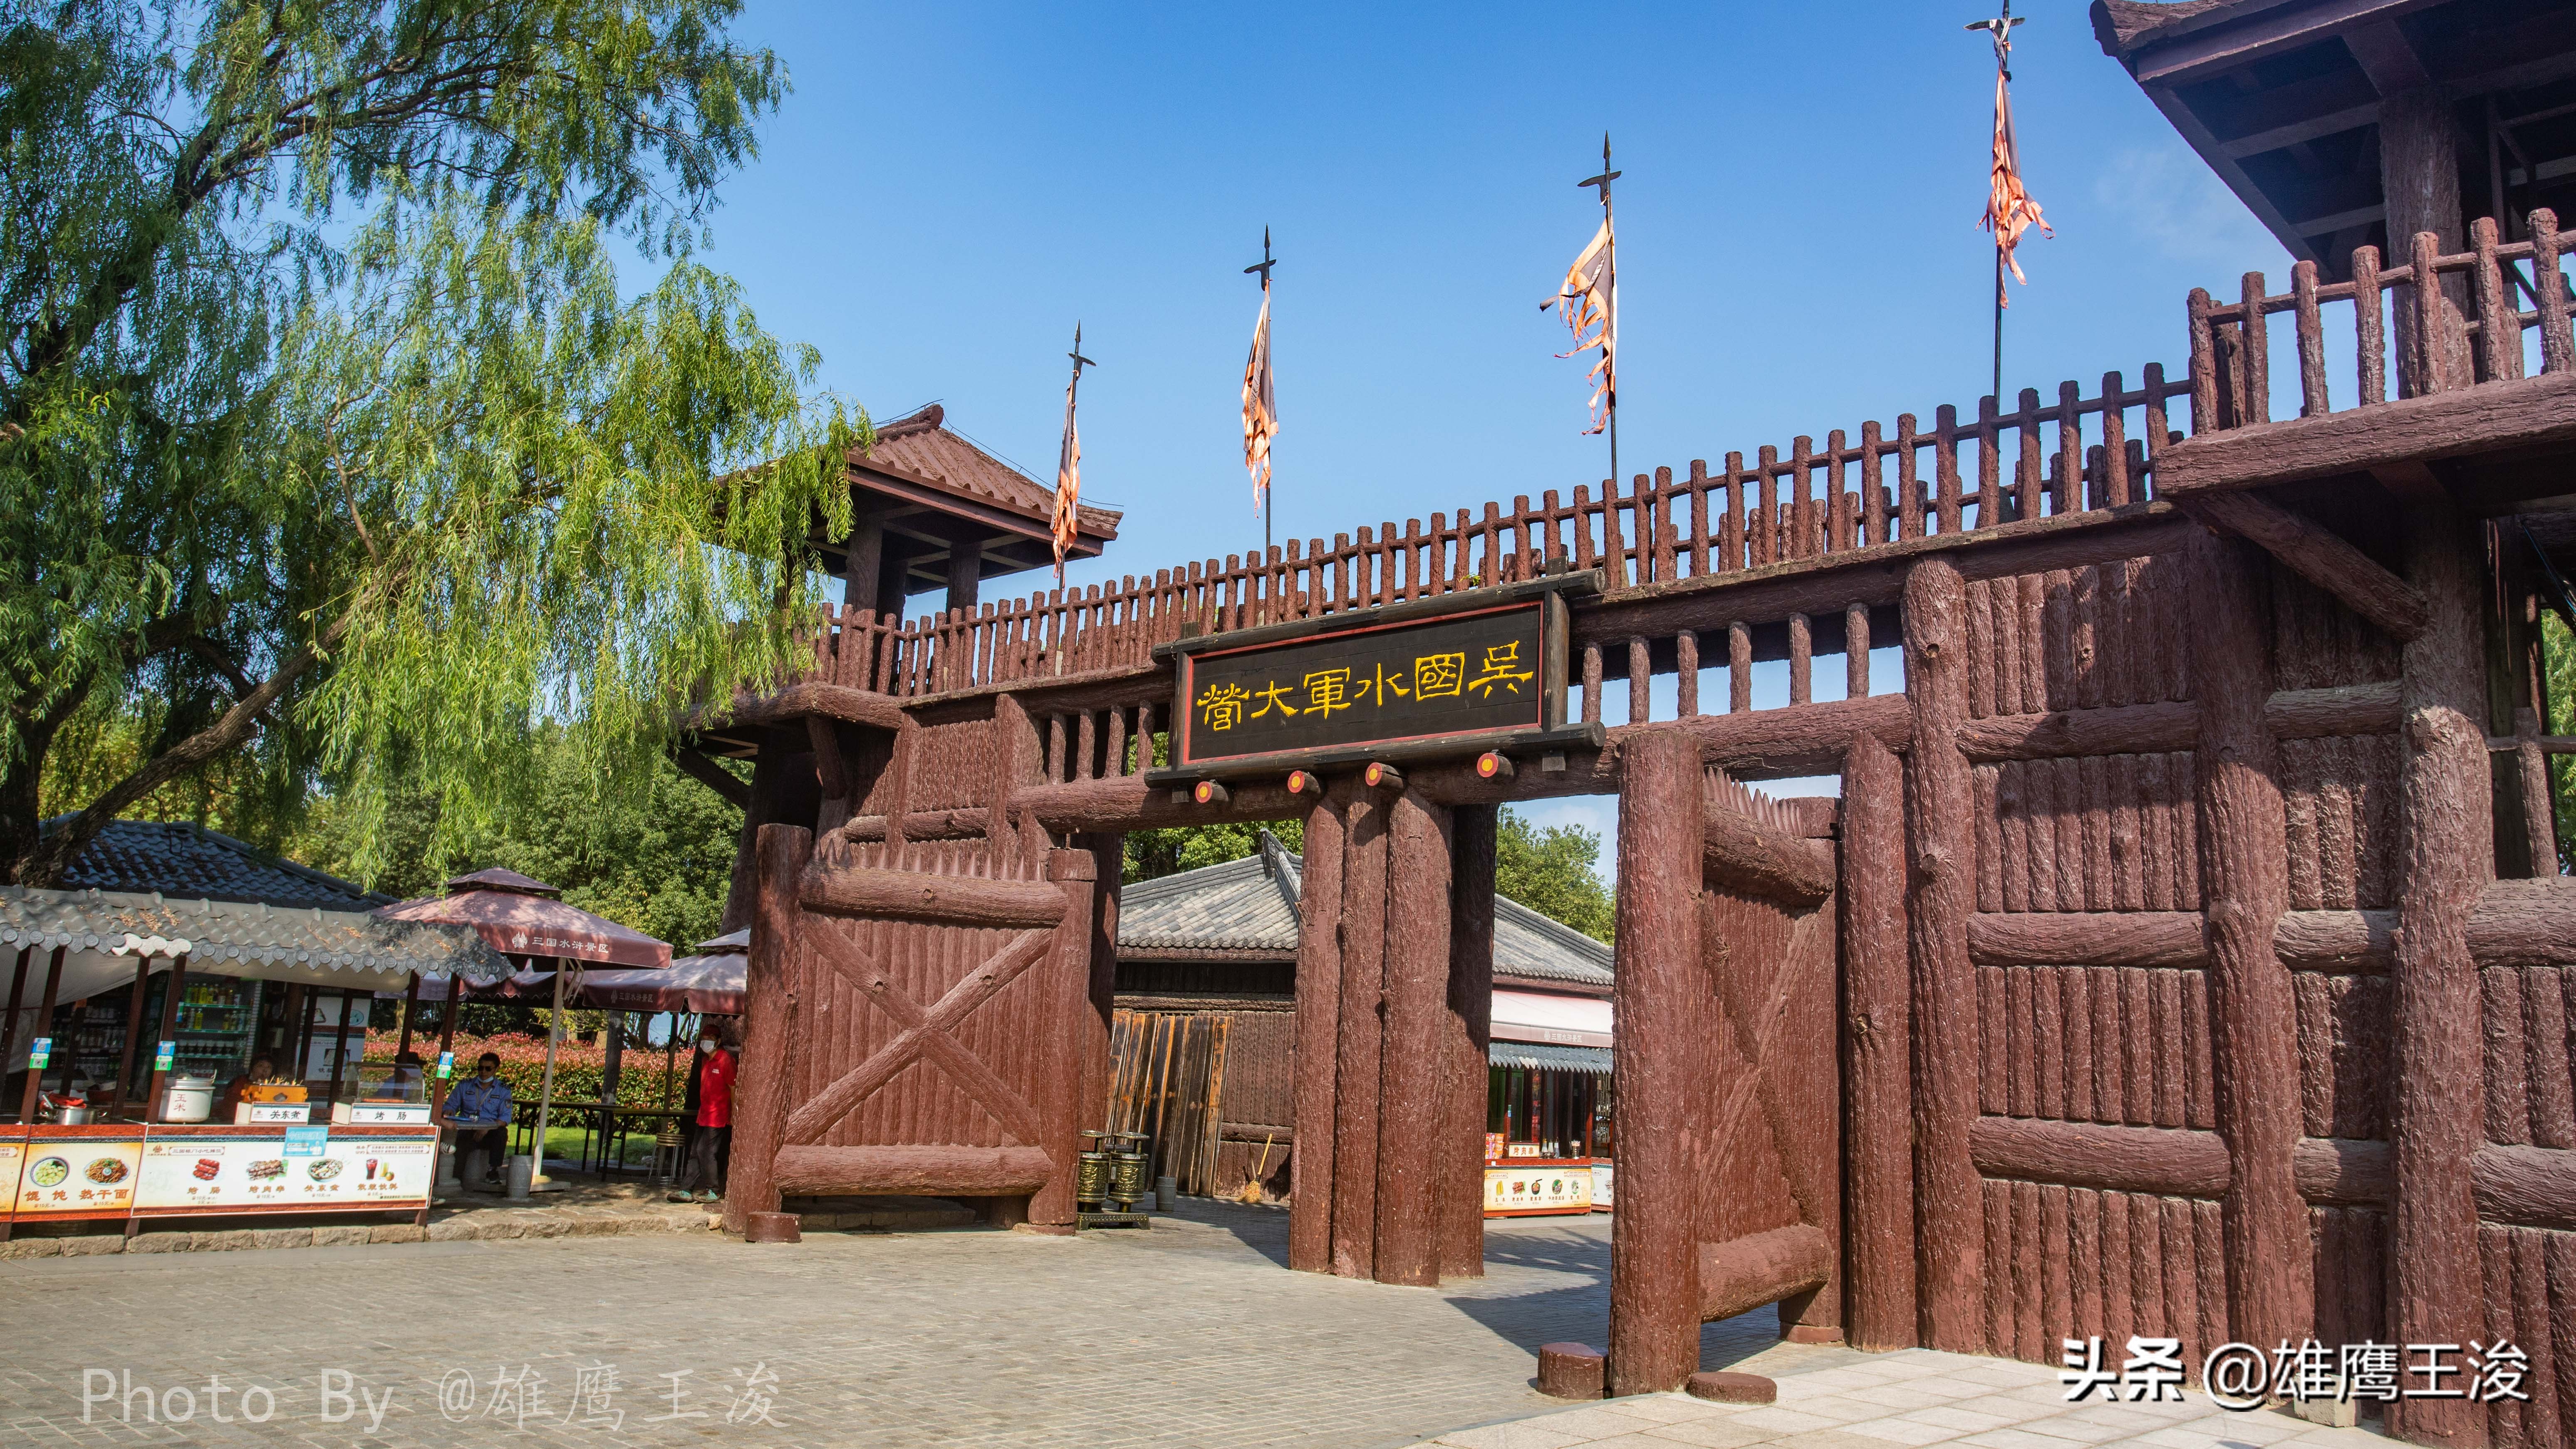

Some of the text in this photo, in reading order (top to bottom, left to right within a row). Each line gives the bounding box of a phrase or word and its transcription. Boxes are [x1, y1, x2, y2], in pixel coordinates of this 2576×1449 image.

[532, 936, 609, 954] 三国水浒景区
[619, 993, 653, 1003] 三国水浒景区
[173, 1094, 187, 1112] 玉米
[270, 1110, 301, 1119] 关东煮
[374, 1111, 406, 1120] 烤肠
[1513, 1147, 1534, 1155] 烤肉串
[25, 1190, 68, 1201] 馄饨
[78, 1188, 130, 1200] 热干面
